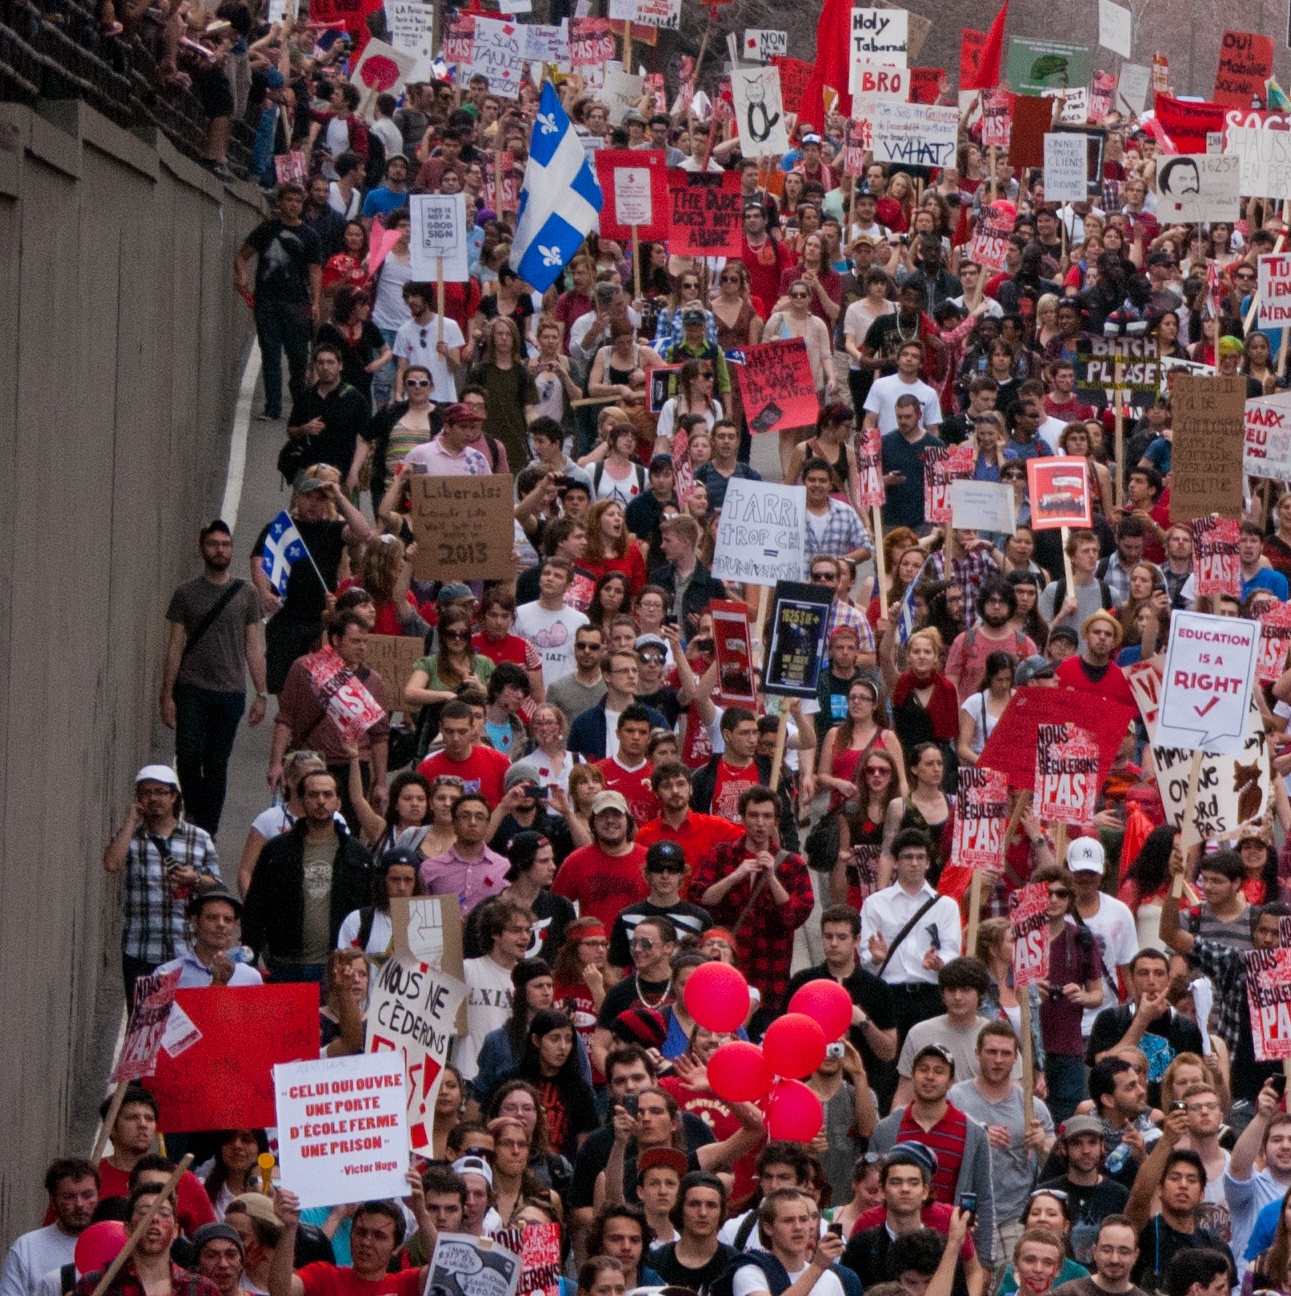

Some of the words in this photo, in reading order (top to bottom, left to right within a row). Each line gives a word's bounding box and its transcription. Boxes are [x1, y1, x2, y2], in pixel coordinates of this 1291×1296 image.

[853, 12, 890, 36] Holy
[861, 71, 901, 92] BRO
[883, 140, 955, 166] WHAT?
[427, 222, 453, 230] GOOD
[428, 230, 453, 239] SIGN
[1092, 337, 1157, 357] BITCH
[1087, 361, 1156, 383] PLEASE
[438, 543, 488, 565] 2013
[1201, 555, 1230, 581] PAS
[1178, 627, 1250, 647] EDUCATION
[1199, 653, 1211, 664] IS
[1215, 655, 1223, 666] A
[1174, 671, 1242, 694] RIGHT
[1042, 773, 1086, 808] PAS
[379, 958, 422, 999] NOUS
[289, 1082, 329, 1099] CELUI
[332, 1080, 354, 1093] QUI
[356, 1074, 402, 1091] OUVRE
[306, 1103, 332, 1116] UNE
[335, 1097, 380, 1113] PORTE
[350, 1114, 398, 1132] FERME
[301, 1143, 328, 1158] UNE
[332, 1136, 382, 1154] PRISON
[375, 1161, 398, 1174] Hugo
